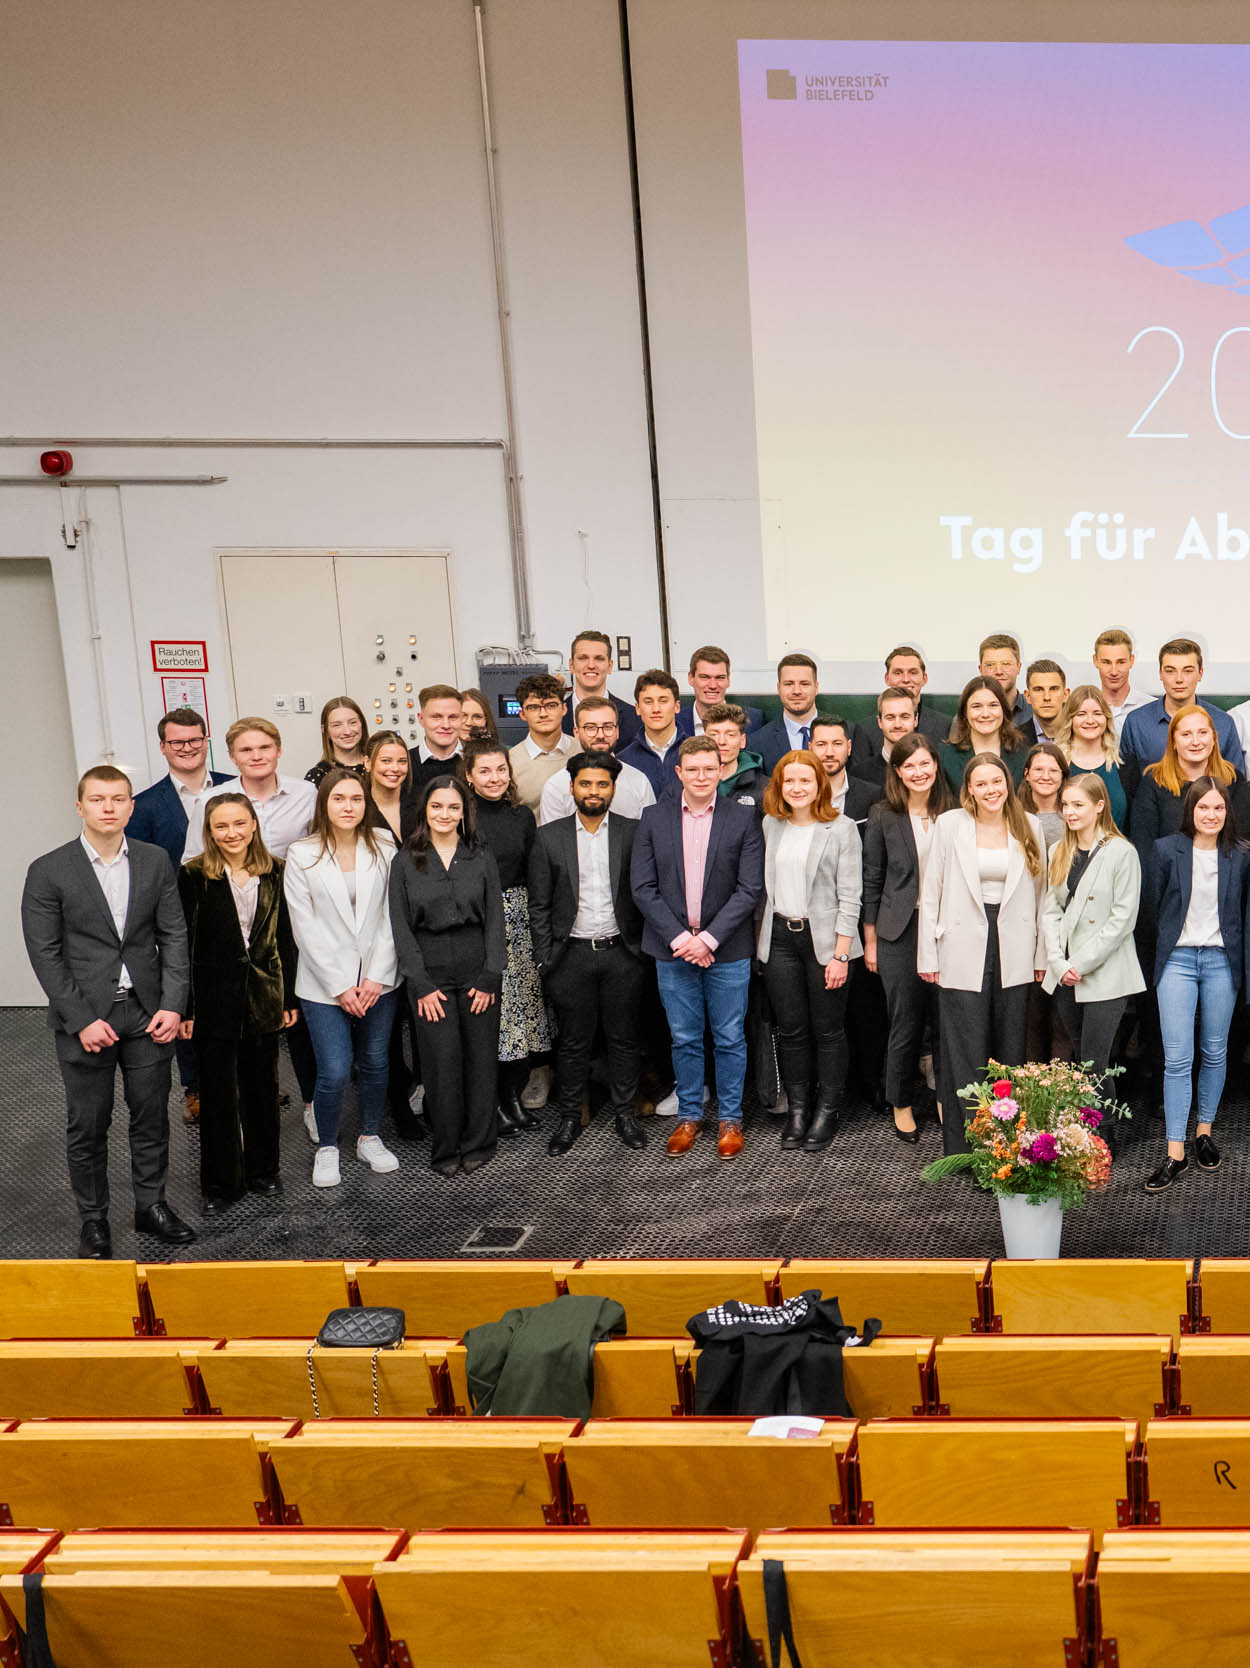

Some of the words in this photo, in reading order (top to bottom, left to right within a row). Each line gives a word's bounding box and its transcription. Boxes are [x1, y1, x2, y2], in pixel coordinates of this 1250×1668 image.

[805, 73, 889, 88] UNIVERSITÄT
[805, 89, 874, 101] BIELEFELD
[939, 514, 1043, 573] Tag
[1064, 511, 1156, 560] für
[158, 647, 200, 657] Rauchen
[158, 657, 203, 666] verboten!
